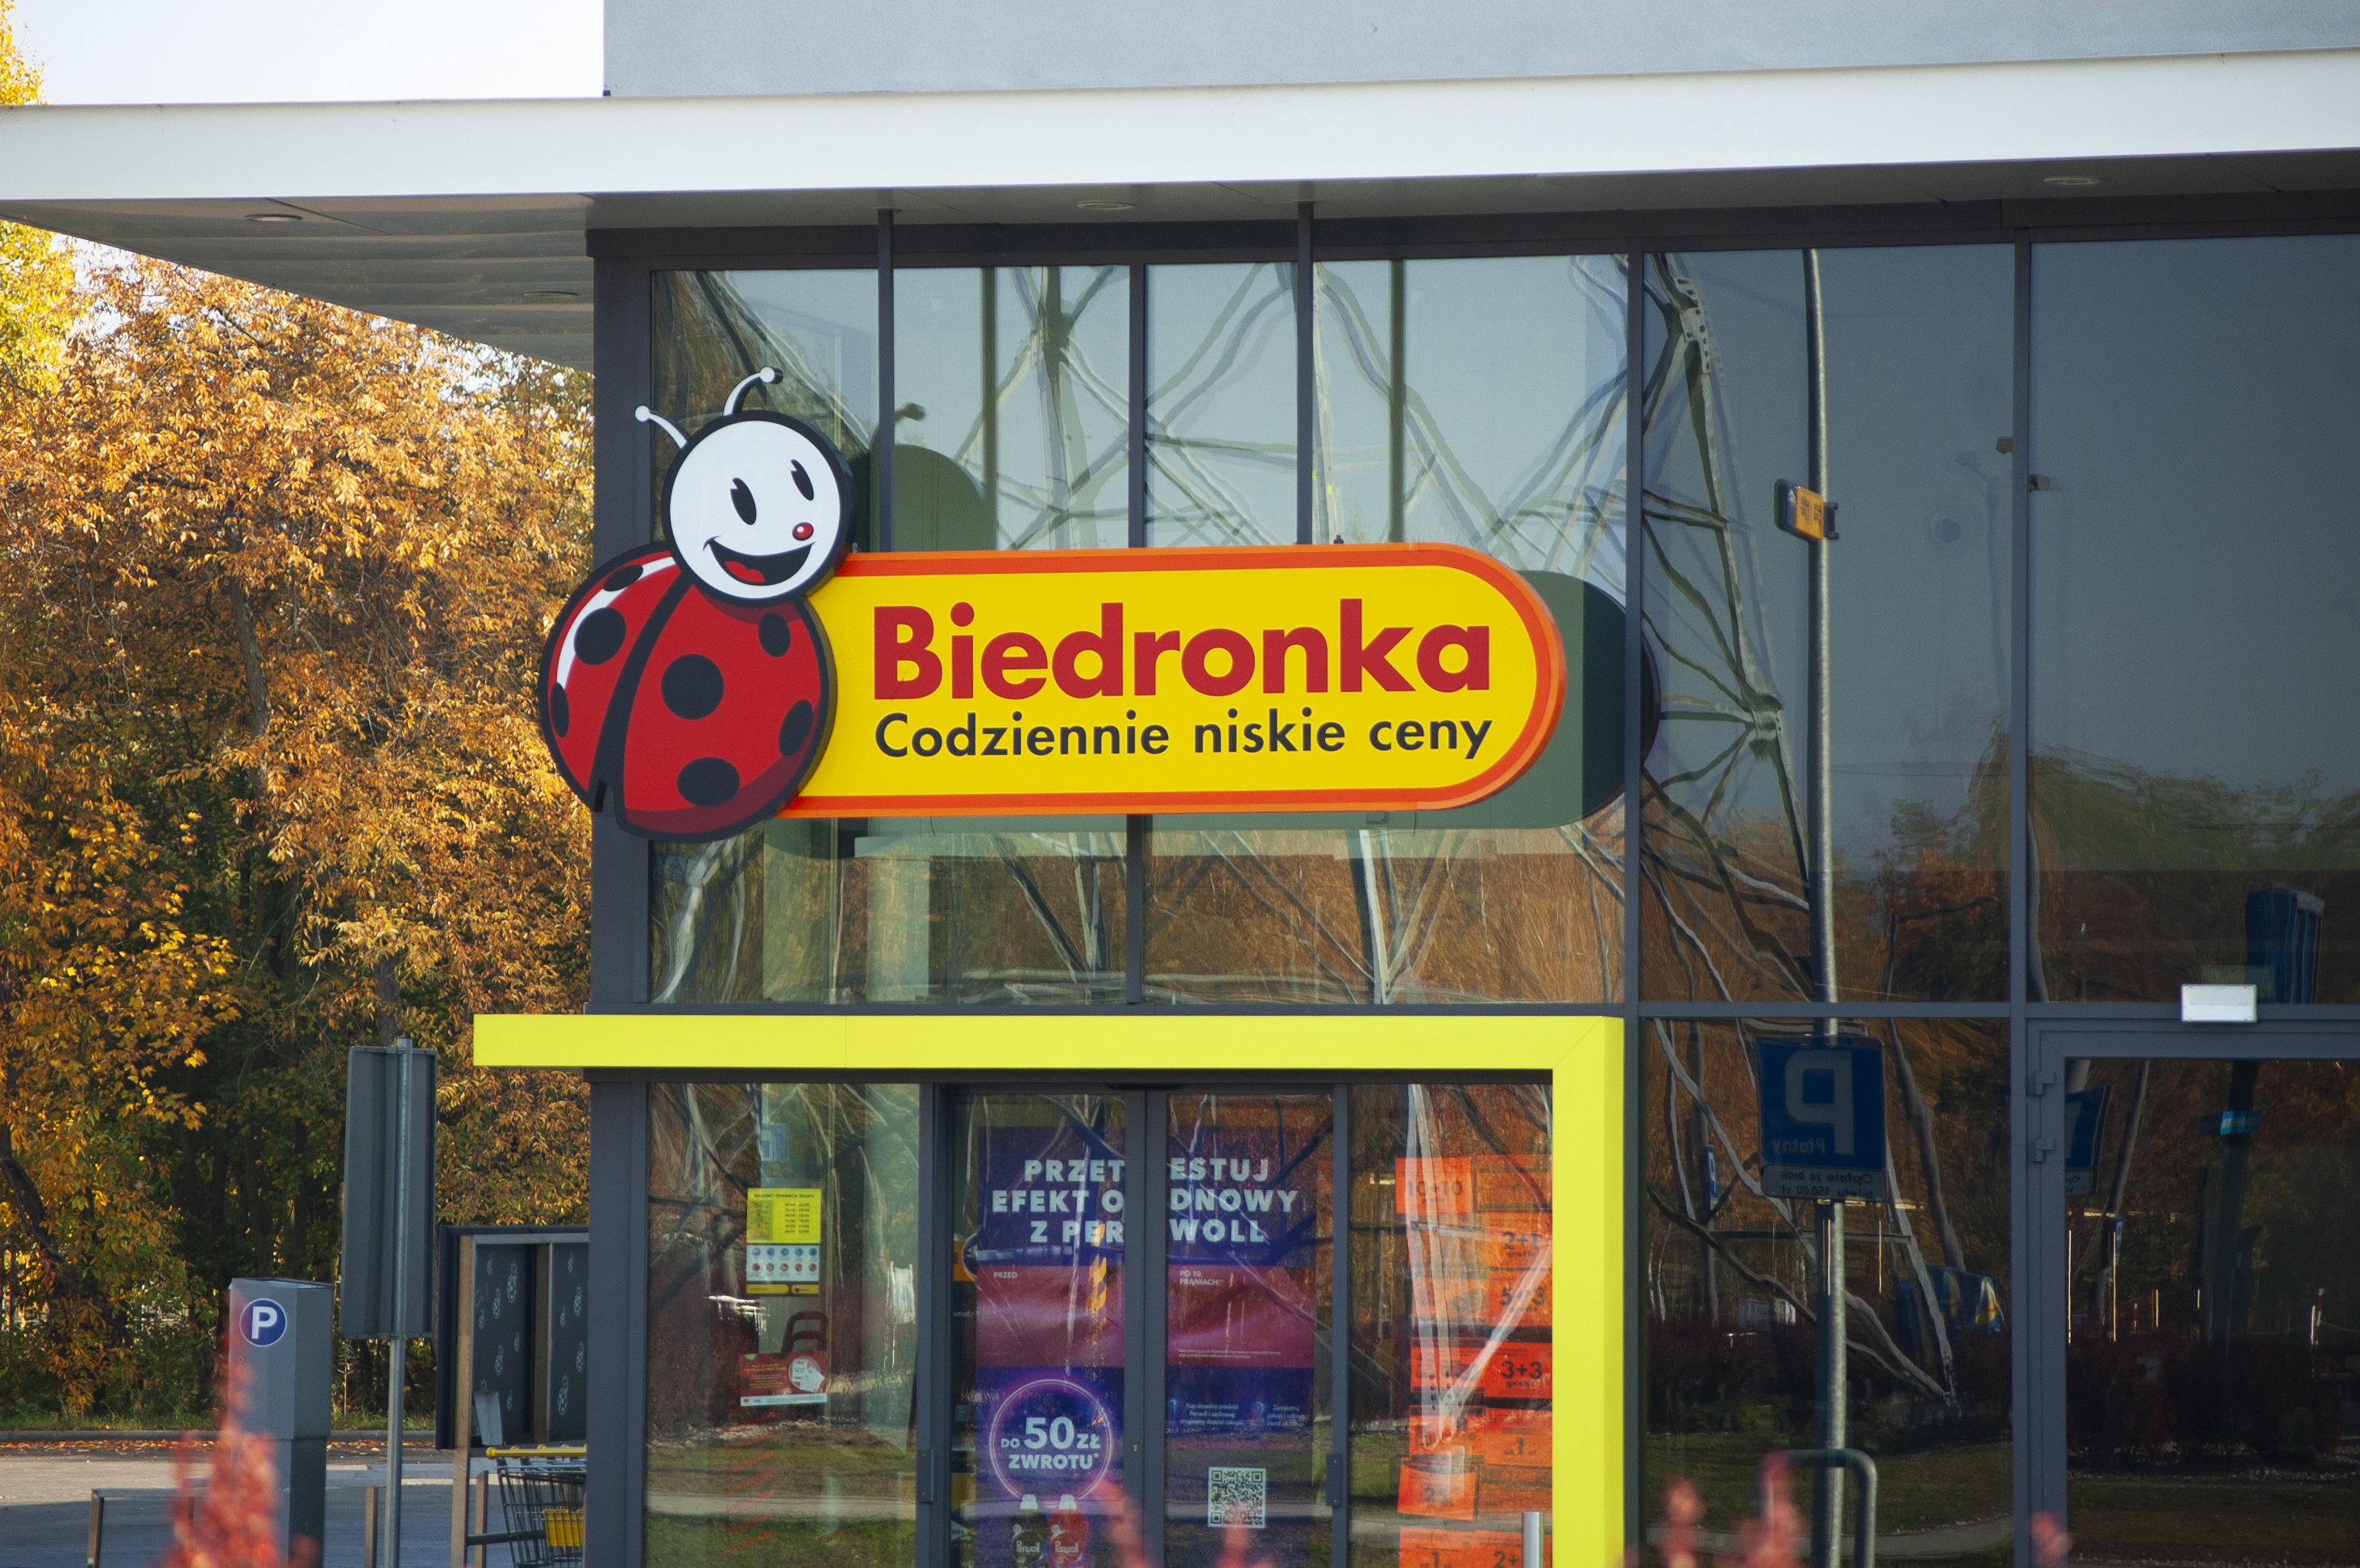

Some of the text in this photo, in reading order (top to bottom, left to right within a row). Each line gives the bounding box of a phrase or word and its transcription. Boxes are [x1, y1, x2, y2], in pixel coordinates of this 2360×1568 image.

[875, 598, 1490, 700] Biedronka
[875, 707, 1493, 760] Codziennie niskie ceny
[992, 1189, 1089, 1213] EFEKT
[1030, 1220, 1048, 1242] Z
[251, 1305, 277, 1339] P
[1502, 1360, 1543, 1379] 3+3
[1000, 1417, 1101, 1450] DO 50 ZŁ
